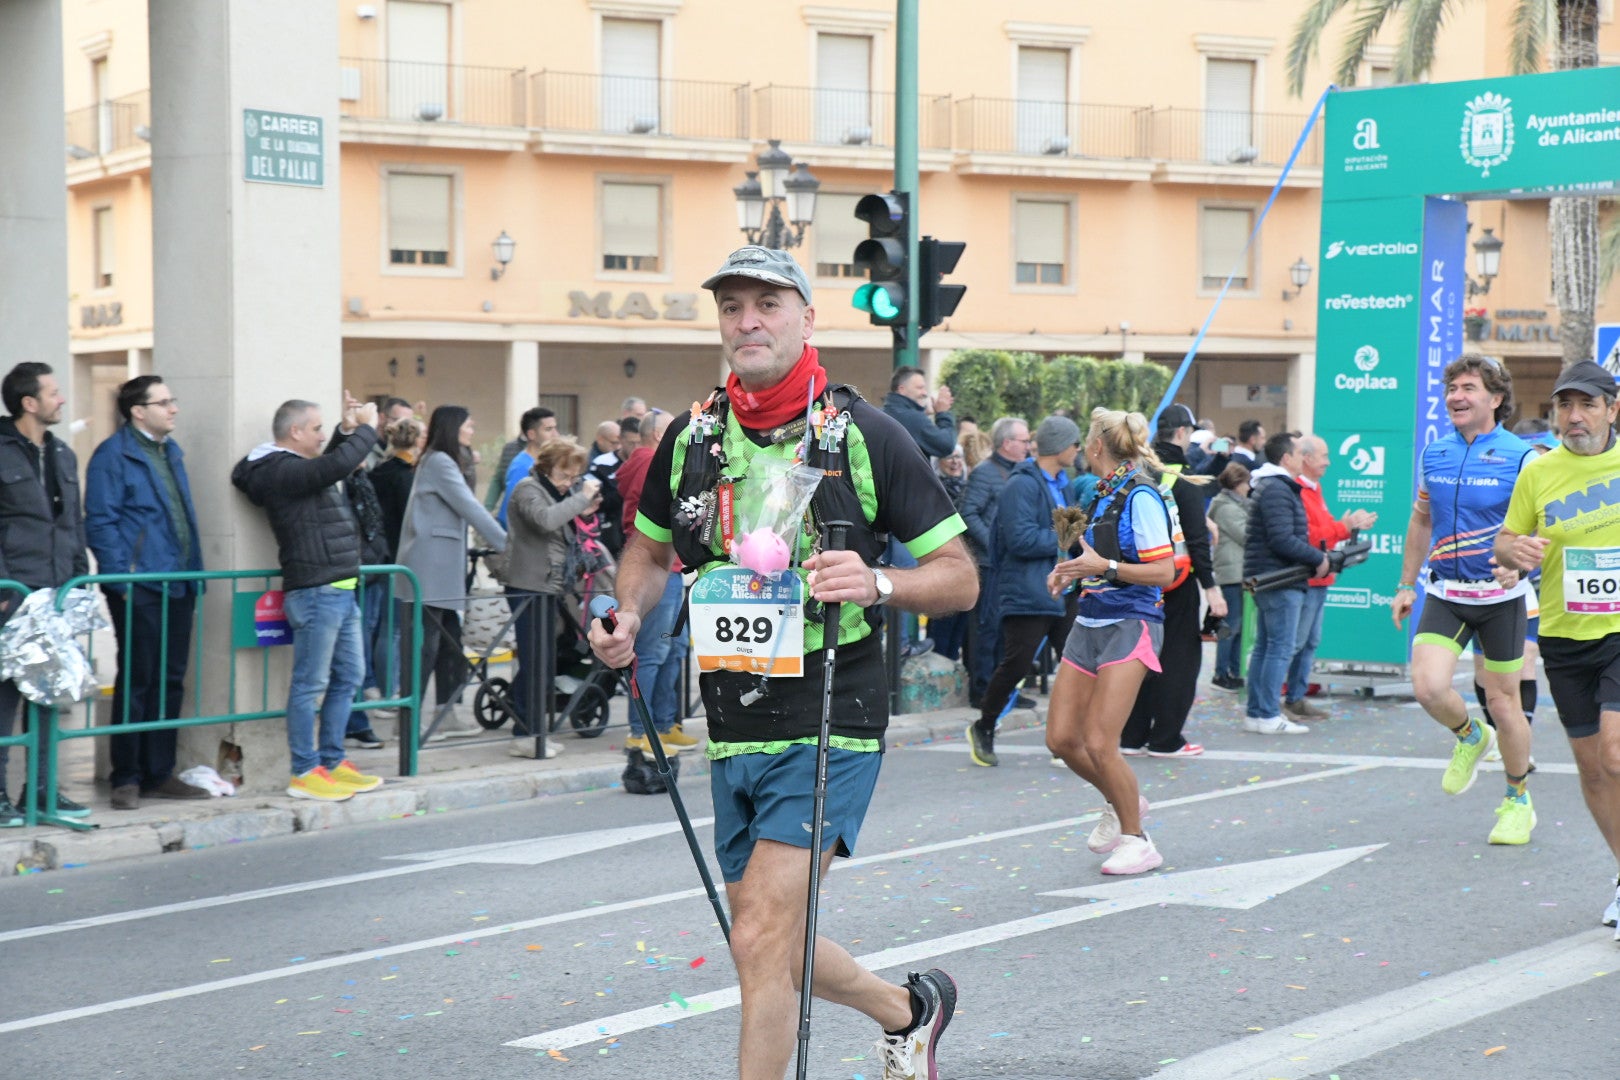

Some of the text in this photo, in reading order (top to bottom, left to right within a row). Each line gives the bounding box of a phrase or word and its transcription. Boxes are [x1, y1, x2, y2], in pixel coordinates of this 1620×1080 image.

[261, 115, 318, 136] CARRER
[1538, 131, 1560, 146] de
[252, 155, 275, 177] DEL
[1345, 242, 1418, 256] vectalia
[568, 290, 698, 320] MAZ
[1335, 373, 1398, 393] Coplaca
[731, 583, 749, 592] Elc
[1577, 578, 1620, 594] 160
[715, 616, 773, 644] 829
